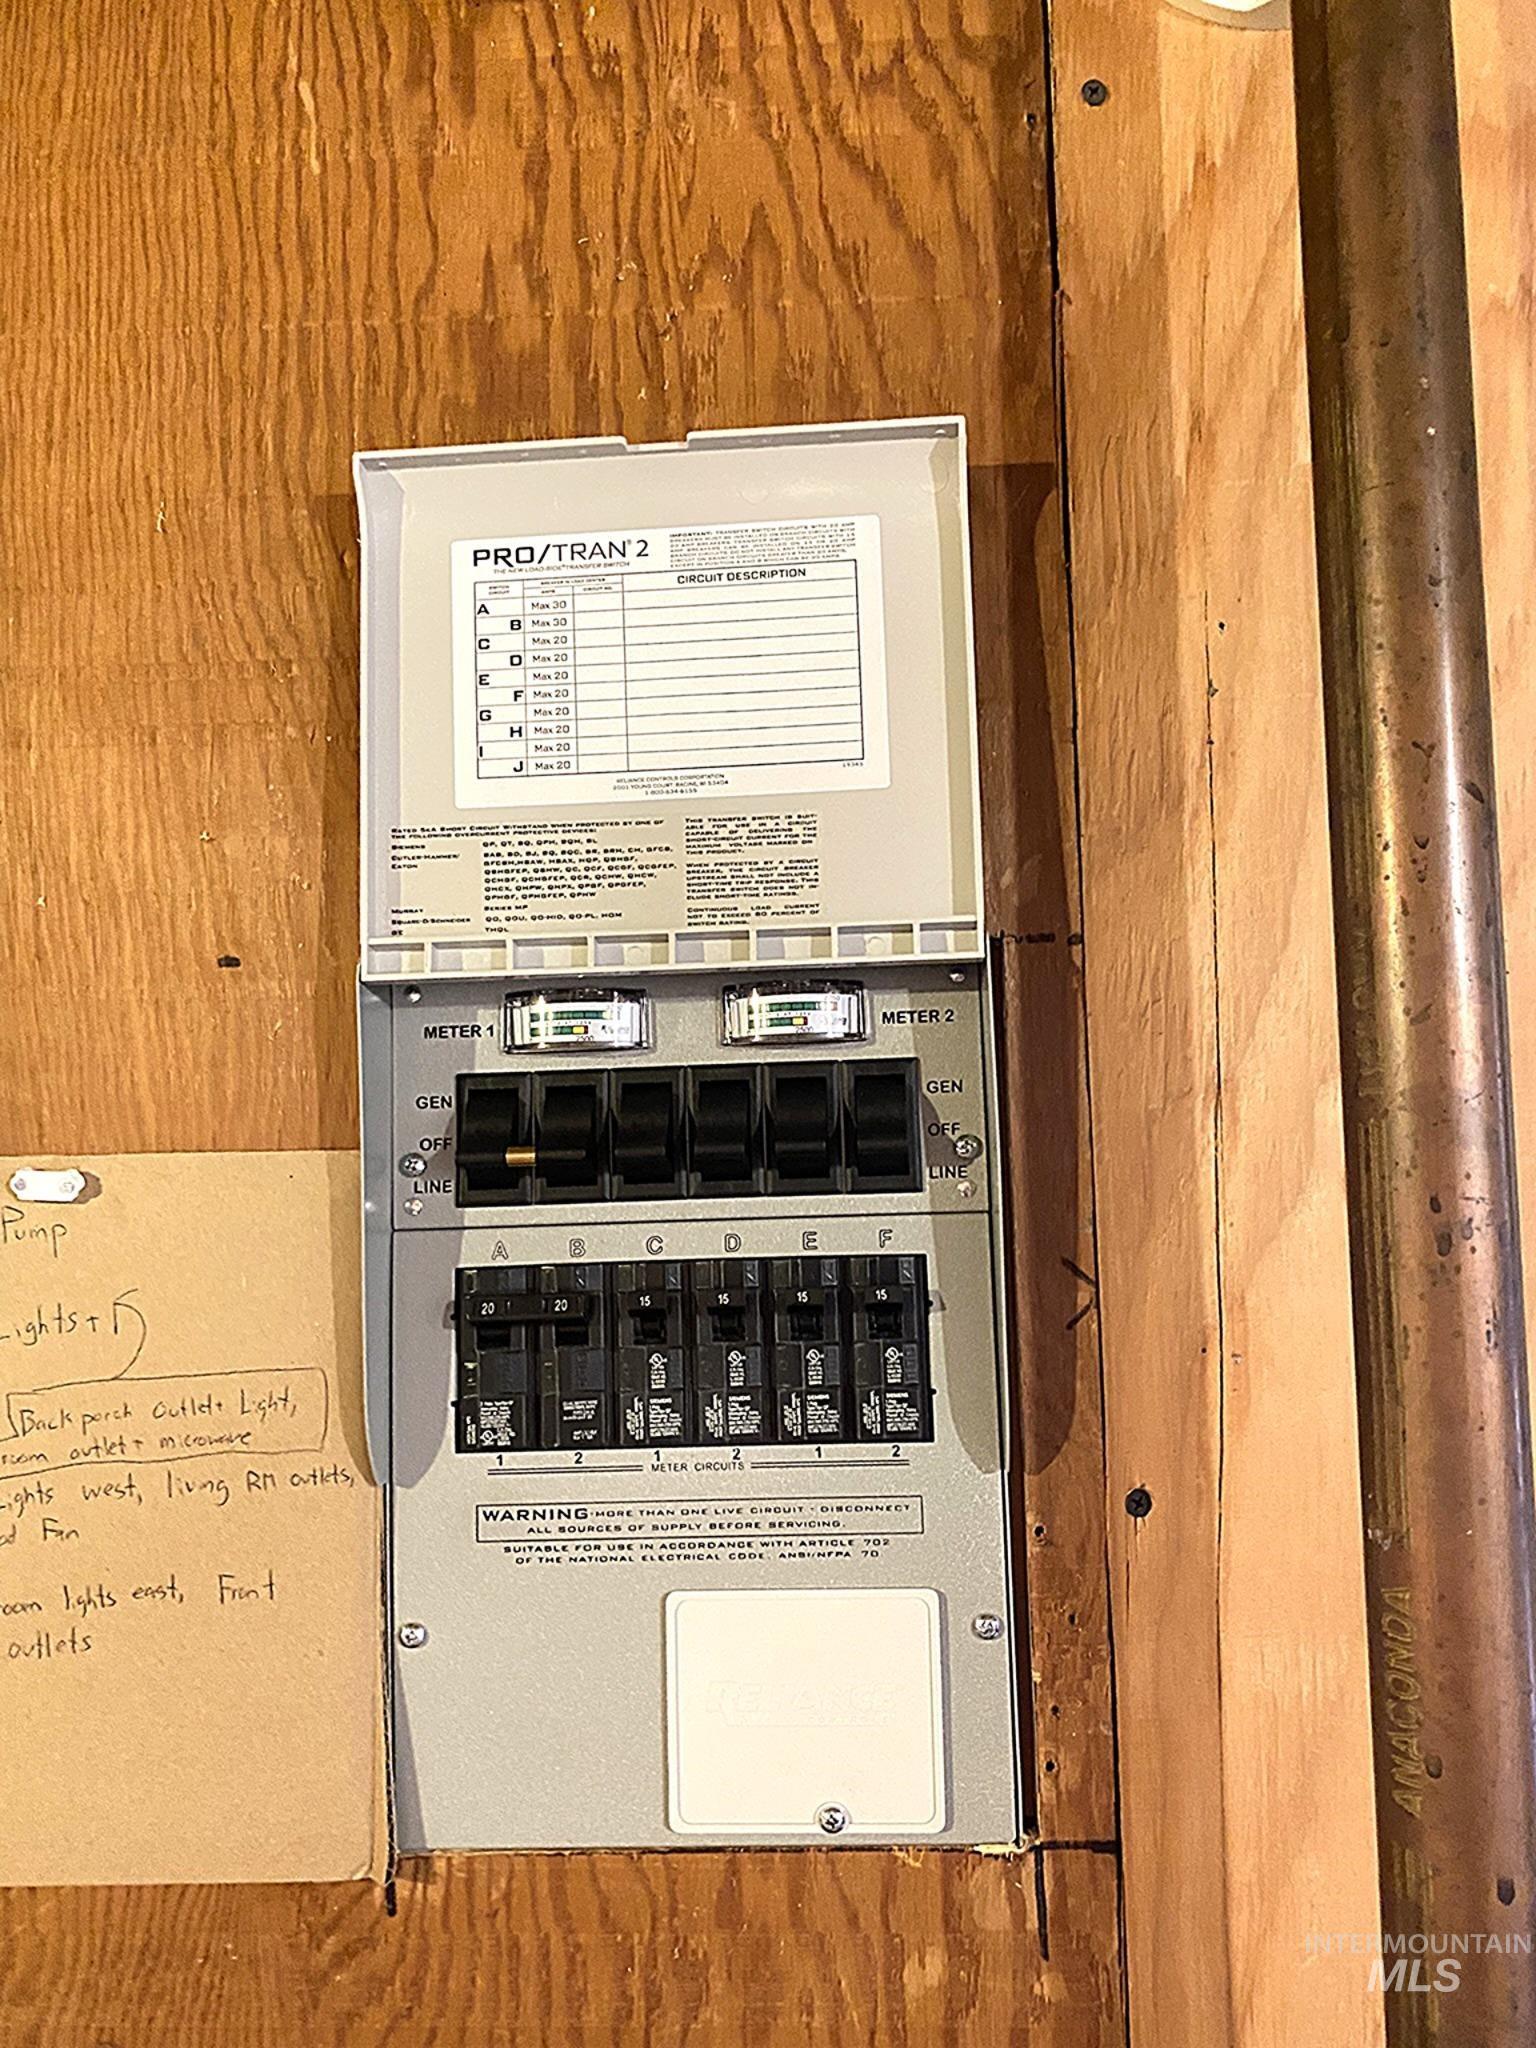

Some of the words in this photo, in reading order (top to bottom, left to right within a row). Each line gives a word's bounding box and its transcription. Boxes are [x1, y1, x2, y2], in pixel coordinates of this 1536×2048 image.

[636, 539, 649, 557] 2
[677, 573, 724, 584] CIRCUIT
[727, 568, 806, 581] DESCRIPTION
[477, 604, 490, 615] A
[531, 602, 550, 610] Max
[552, 600, 567, 609] 30
[510, 619, 522, 631] B
[531, 619, 550, 627] Max
[553, 617, 567, 626] 30
[478, 638, 490, 650] C
[531, 637, 551, 645] Max
[553, 635, 567, 644] 20
[510, 655, 522, 666] D
[553, 653, 568, 662] 20
[479, 674, 490, 686] E
[532, 672, 552, 680] Max
[554, 671, 568, 680] 20
[513, 690, 524, 702] F
[533, 690, 552, 698] Max
[554, 688, 569, 698] 20
[479, 710, 492, 721] G
[533, 708, 552, 716] Max
[555, 706, 569, 716] 20
[510, 726, 522, 738] H
[534, 726, 553, 734] Max
[555, 724, 570, 734] 20
[534, 744, 554, 752] Max
[556, 742, 570, 752] 20
[513, 761, 524, 773] J
[535, 762, 554, 770] Max
[556, 760, 571, 770] 20
[882, 1010, 939, 1025] METER
[945, 1009, 955, 1022] 2
[423, 1024, 482, 1039] METER
[486, 1024, 494, 1038] 1
[926, 1080, 963, 1093] GEN
[416, 1095, 452, 1109] GEN
[928, 1123, 961, 1136] OFF
[419, 1138, 452, 1151] OFF
[929, 1166, 968, 1179] LINE
[414, 1180, 452, 1193] LINE
[2, 1205, 67, 1258] Pump
[491, 1240, 509, 1260] A
[569, 1238, 586, 1257] B
[646, 1236, 664, 1254] C
[724, 1233, 741, 1252] D
[803, 1231, 818, 1250] E
[879, 1229, 892, 1248] F
[640, 1295, 651, 1306] 15
[718, 1293, 729, 1304] 15
[797, 1291, 808, 1302] 15
[876, 1289, 887, 1300] 15
[481, 1302, 495, 1315] 20
[554, 1299, 568, 1311] 20
[69, 1434, 127, 1460] outlet
[816, 1446, 822, 1458] 1
[892, 1445, 900, 1457] 2
[574, 1452, 583, 1464] 2
[655, 1451, 660, 1461] 1
[732, 1448, 741, 1460] 2
[497, 1455, 503, 1466] 1
[651, 1463, 688, 1473] METER
[694, 1461, 744, 1472] CIRCUITS
[82, 1472, 143, 1505] west,
[168, 1470, 230, 1507] living
[289, 1464, 355, 1489] outlets,
[482, 1508, 588, 1523] WARNING
[639, 1509, 675, 1517] THAN
[680, 1508, 708, 1516] ONE
[714, 1507, 743, 1515] LIVE
[750, 1506, 803, 1514] CIRCUIT
[820, 1504, 909, 1513] DISCONNECT
[527, 1526, 552, 1534] ALL
[558, 1524, 622, 1533] SOURCES
[627, 1524, 645, 1532] OF
[651, 1523, 702, 1532] SUPPLY
[709, 1521, 761, 1530] BEFORE
[768, 1520, 846, 1529] SERVICING.
[503, 1544, 568, 1553] SUITABLE
[574, 1543, 602, 1552] FOR
[607, 1543, 633, 1551] USE
[639, 1543, 653, 1551] IN
[659, 1541, 754, 1550] ACCORDANCE
[759, 1540, 793, 1548] WITH
[799, 1539, 854, 1548] ARTICLE
[863, 1538, 890, 1546] 702
[515, 1556, 532, 1565] OF
[537, 1556, 562, 1564] THE
[568, 1554, 634, 1563] NATIONAL
[641, 1553, 720, 1562] ELECTRICAL
[861, 1549, 880, 1557] 70
[63, 1583, 117, 1618] lights
[132, 1573, 184, 1604] east,
[218, 1569, 275, 1604] Front
[8, 1626, 92, 1660] outlets
[1381, 1586, 1424, 1820] ANACONDA
